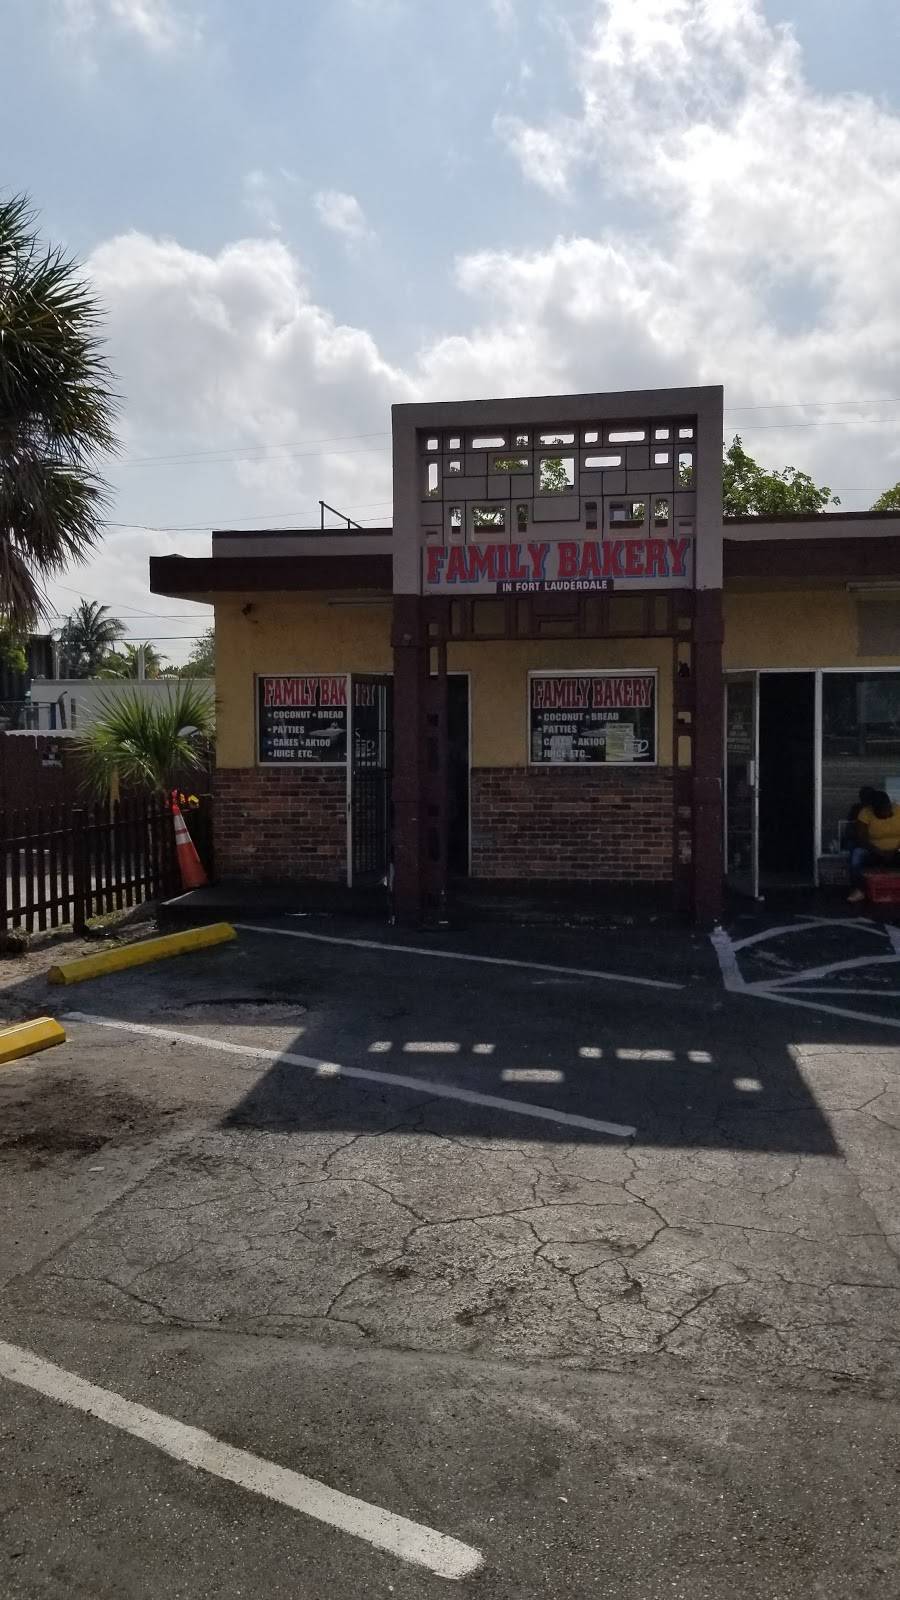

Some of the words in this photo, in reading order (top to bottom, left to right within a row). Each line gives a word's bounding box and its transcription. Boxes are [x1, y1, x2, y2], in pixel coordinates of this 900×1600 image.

[426, 543, 550, 583] FAMILY
[557, 538, 691, 579] BAKERY
[502, 583, 512, 592] IN
[515, 582, 540, 592] FORT
[544, 580, 608, 591] LAUDERDALE
[264, 678, 319, 707] FAMILY
[533, 679, 590, 709] FAMILY
[592, 678, 653, 708] BAKERY
[273, 710, 311, 719] COCONUT
[318, 710, 343, 719] BREAD
[543, 712, 584, 721] COCONUT
[591, 712, 619, 721] BREAD
[272, 725, 305, 734] PATTIES
[543, 725, 578, 734] PATTIES
[273, 738, 299, 747] CAKES
[273, 749, 295, 758] JUICE
